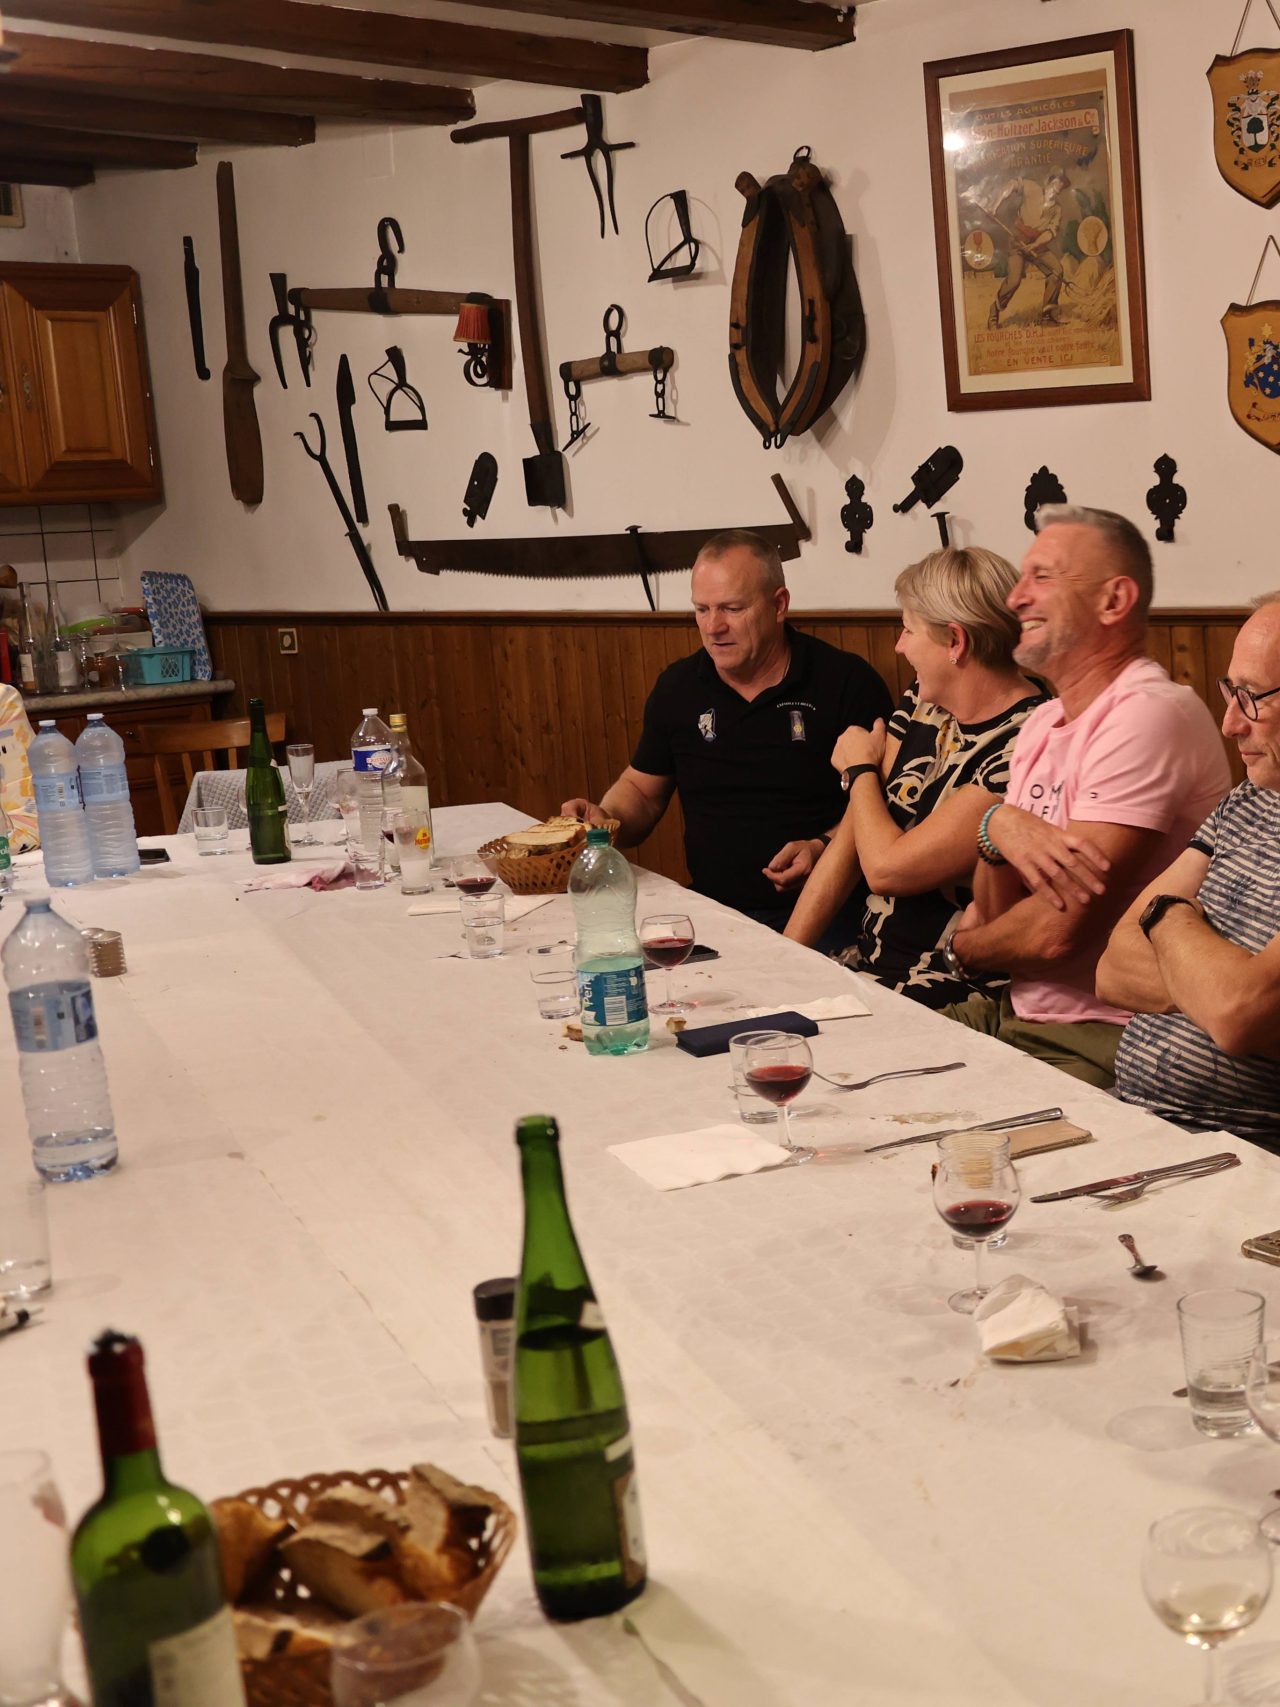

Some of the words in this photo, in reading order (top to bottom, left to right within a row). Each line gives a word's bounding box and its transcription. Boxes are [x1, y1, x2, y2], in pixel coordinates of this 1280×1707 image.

[1017, 100, 1076, 115] AGRICOLES
[1007, 358, 1018, 367] EN
[1025, 354, 1054, 365] VENTE
